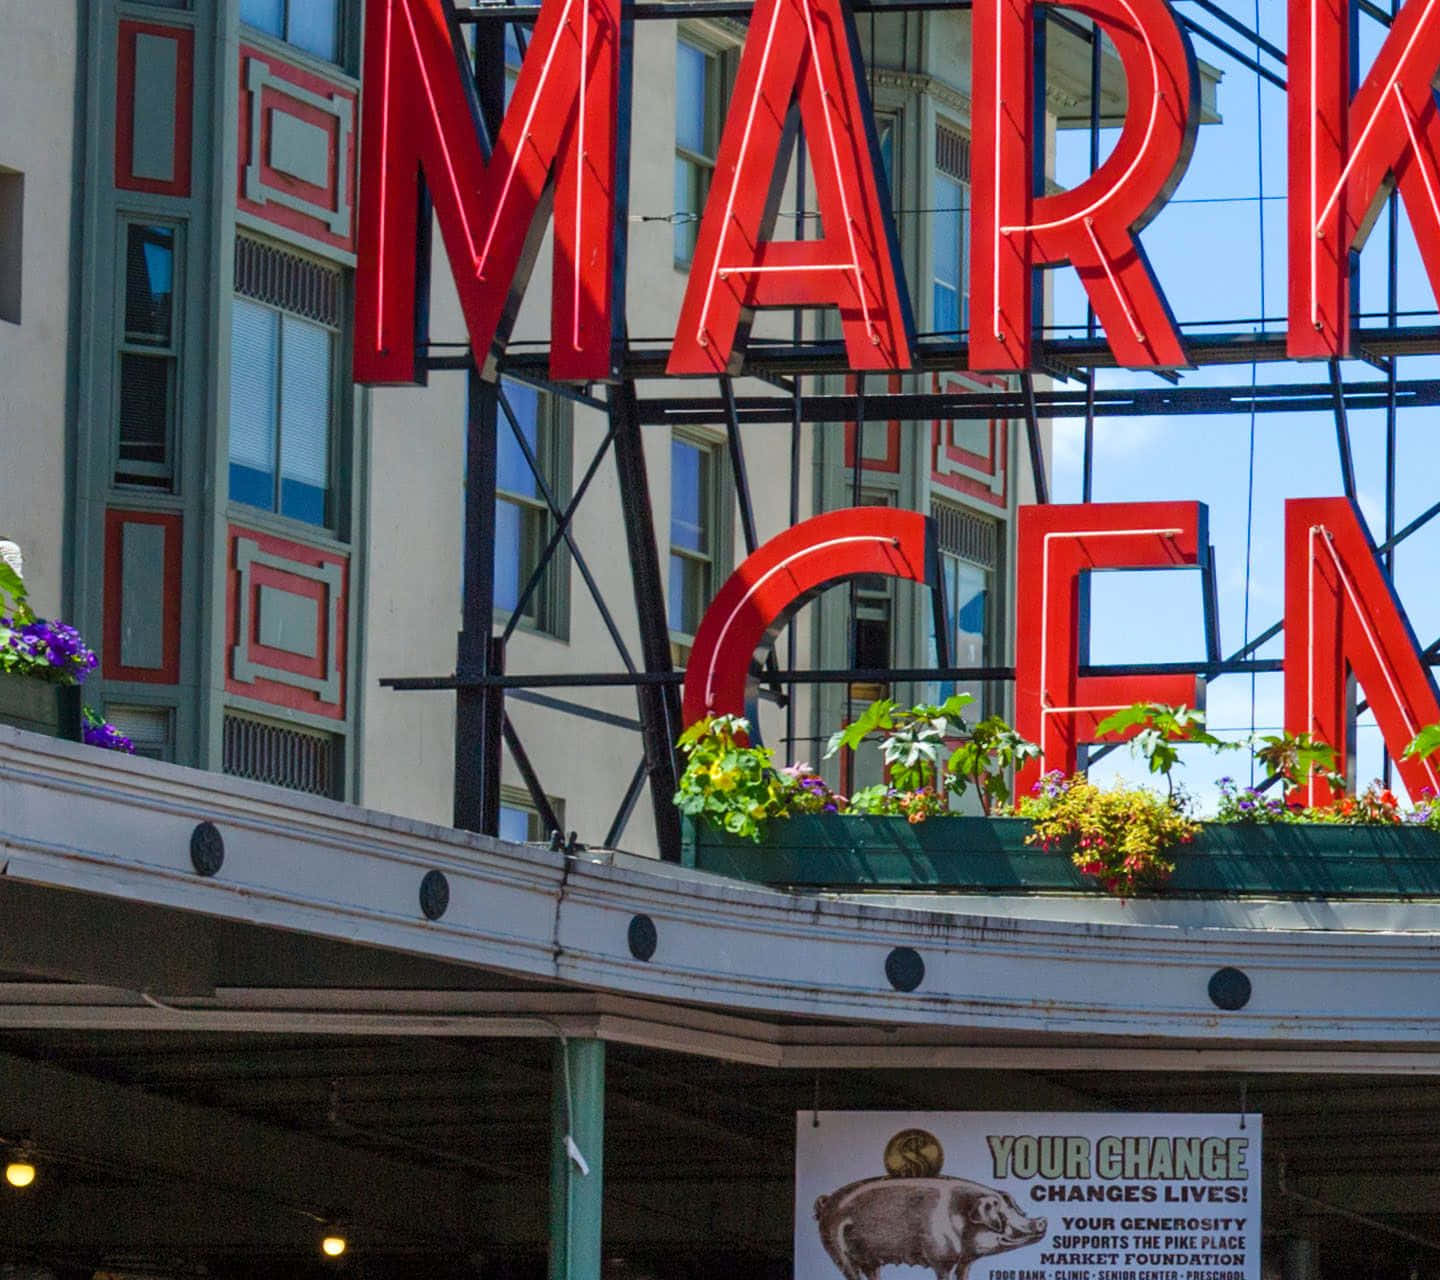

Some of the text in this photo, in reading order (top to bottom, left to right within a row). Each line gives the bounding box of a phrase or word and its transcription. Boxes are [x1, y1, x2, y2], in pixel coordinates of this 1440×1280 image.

[986, 1134, 1249, 1181] YOUR CHANGE
[1030, 1185, 1248, 1203] CHANGES LIVES!
[1062, 1217, 1247, 1231] YOUR GENEROSITY
[1052, 1235, 1246, 1250] SUPPORTS THE PIKE PLACE
[1040, 1252, 1246, 1266] MARKET FOUNDATION
[989, 1270, 1015, 1280] FOOD
[1019, 1270, 1046, 1280] BANK
[1055, 1270, 1090, 1280] CLINIC
[1098, 1270, 1137, 1280] SENIOR
[1138, 1270, 1178, 1280] CENTER
